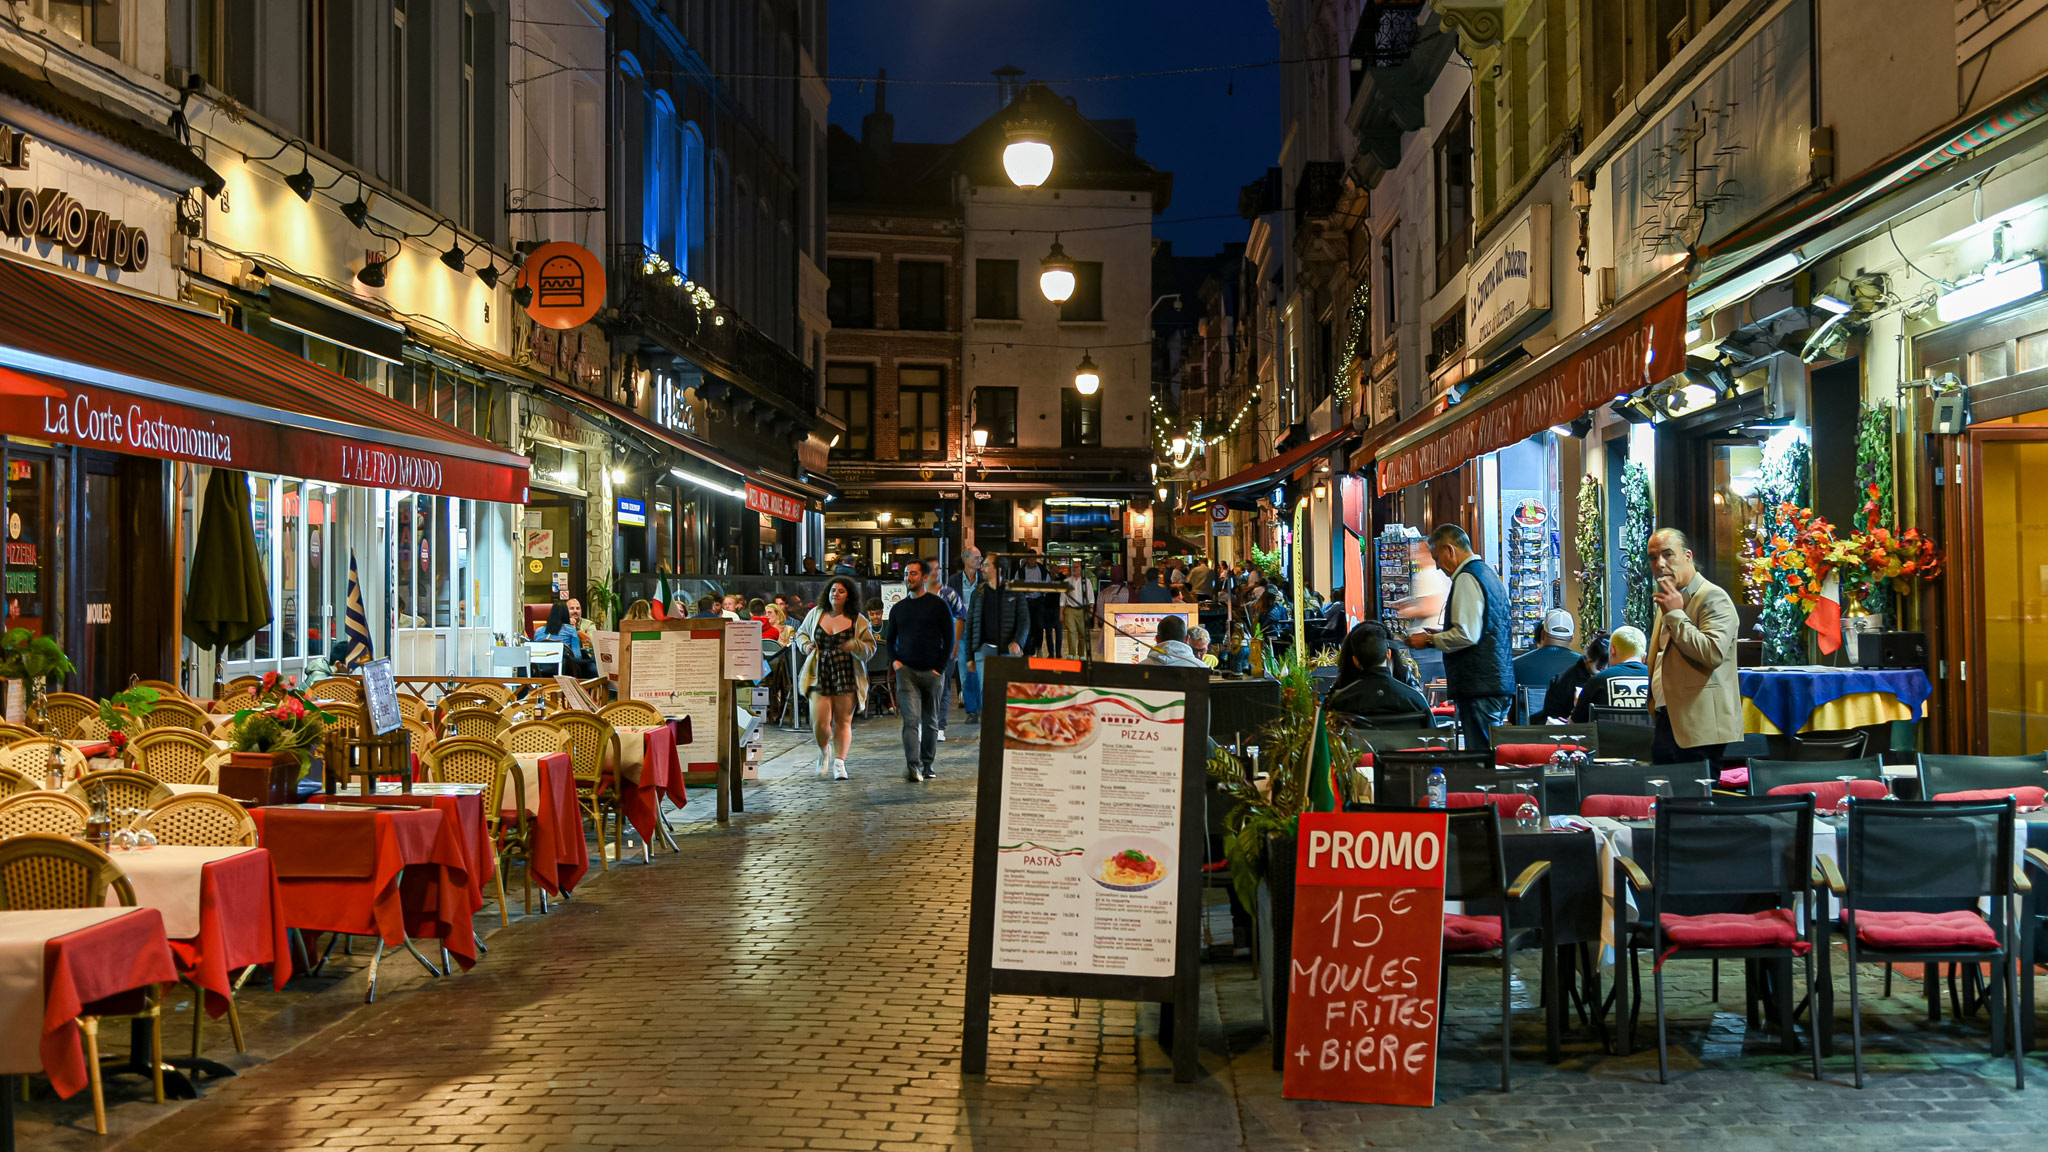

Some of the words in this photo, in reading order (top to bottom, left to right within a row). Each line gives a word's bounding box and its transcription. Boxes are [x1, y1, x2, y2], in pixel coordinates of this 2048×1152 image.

[44, 396, 69, 435] La
[74, 394, 123, 444] Corte
[128, 404, 232, 462] Gastronomica
[341, 445, 397, 485] L'ALTRO
[399, 454, 442, 491] MONDO
[86, 604, 111, 624] MOULES
[1121, 730, 1160, 742] PIZZAS
[1023, 856, 1062, 867] PASTAS
[1308, 830, 1440, 871] PROMO
[1292, 955, 1421, 997] MOULES
[1294, 1044, 1311, 1066] +
